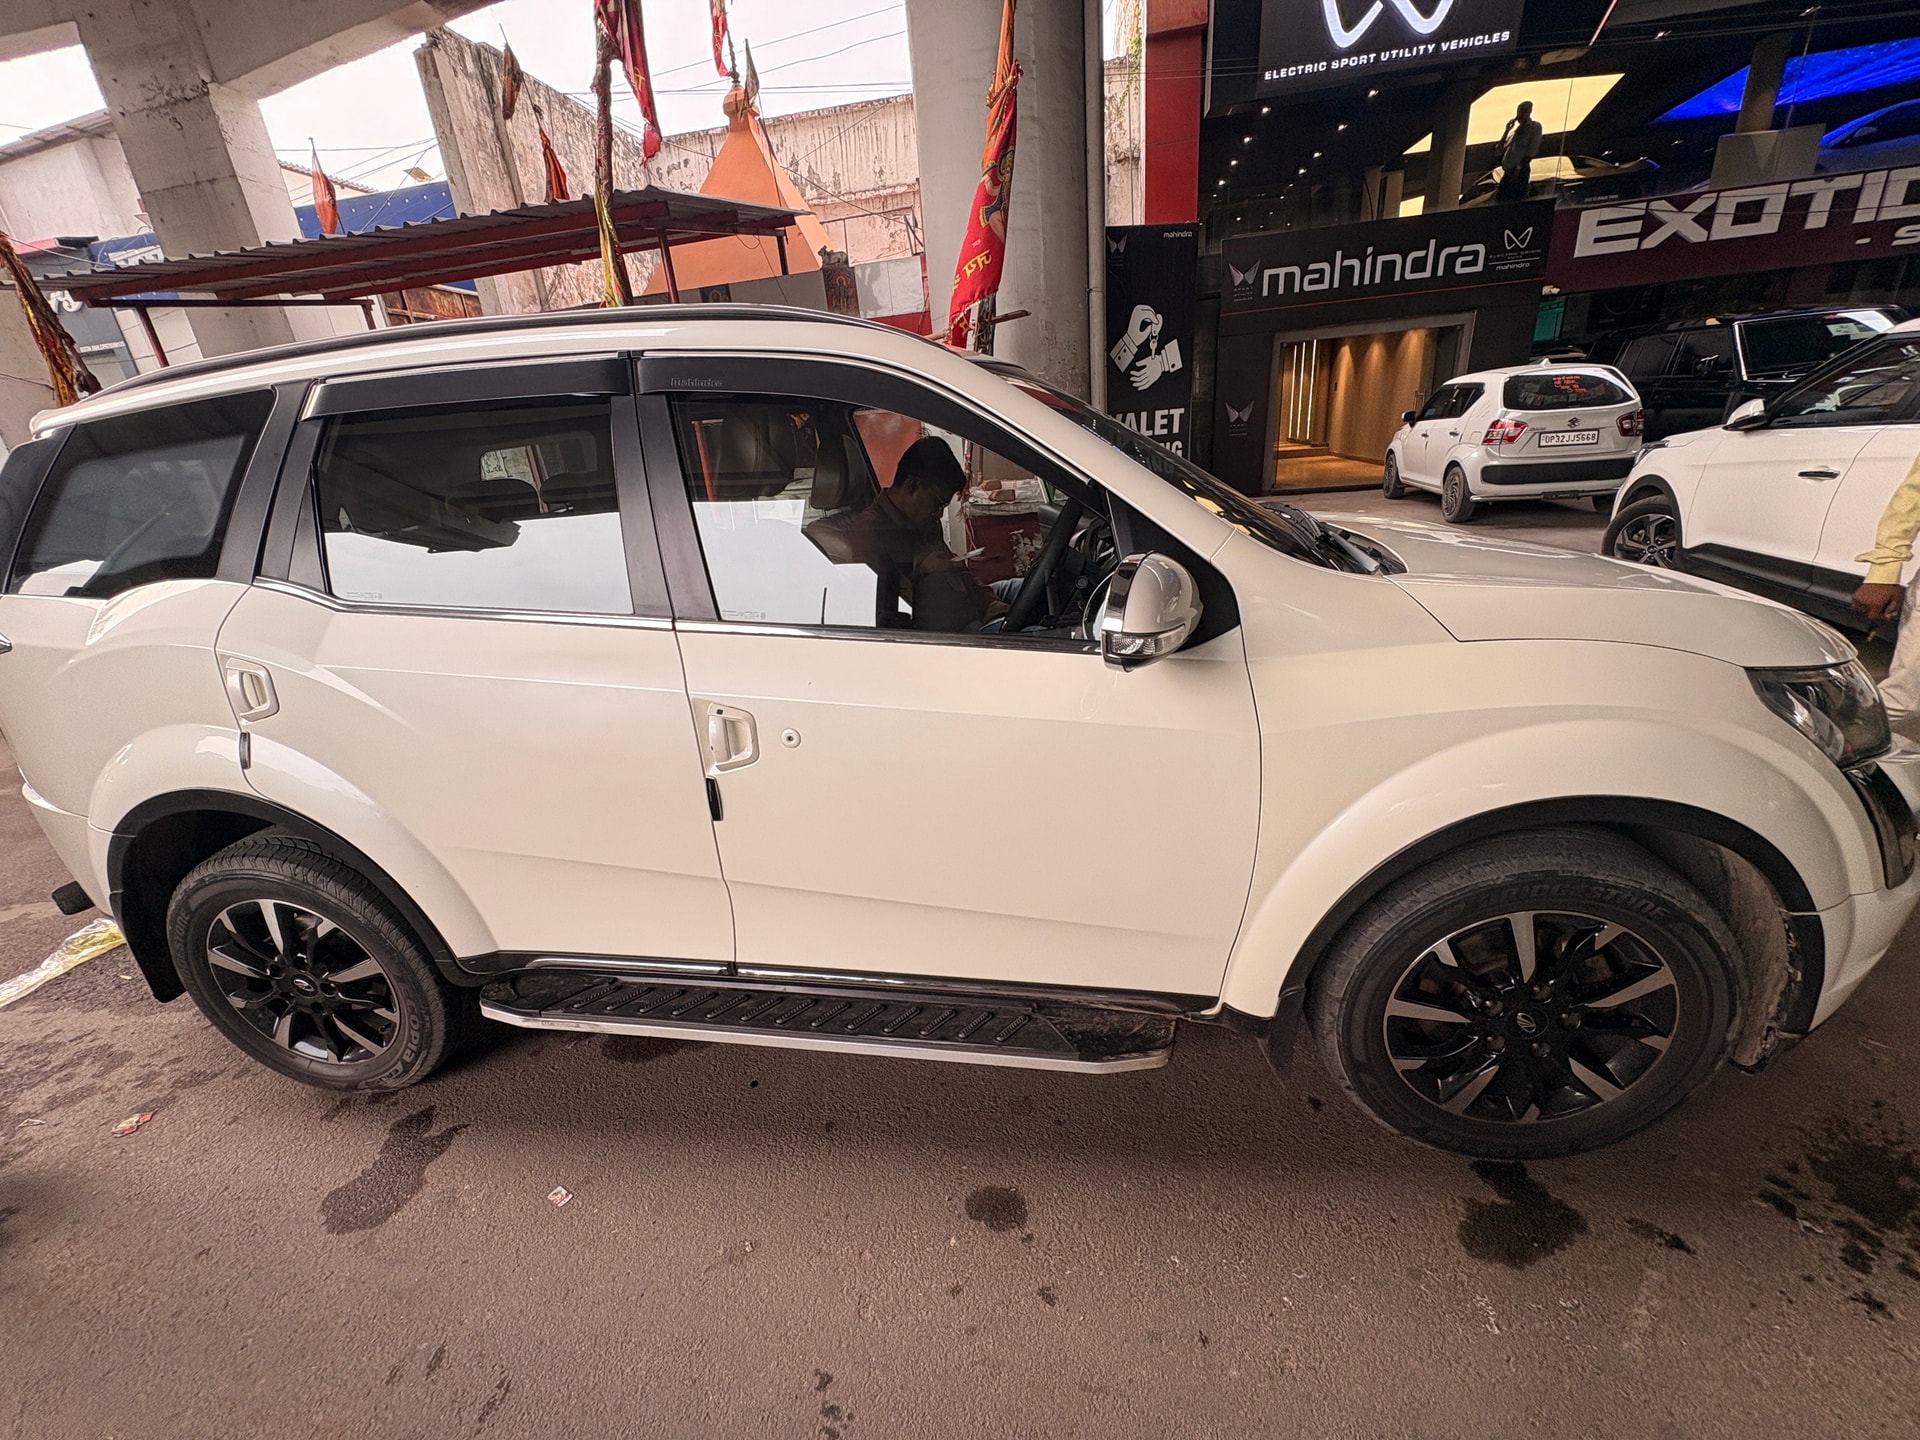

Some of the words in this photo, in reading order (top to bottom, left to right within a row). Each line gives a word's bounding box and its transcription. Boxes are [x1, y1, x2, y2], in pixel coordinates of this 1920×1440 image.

[1264, 61, 1328, 81] ELECTRIC
[1331, 53, 1377, 70] SPORT
[1380, 43, 1436, 62] UTILITY
[1441, 31, 1511, 51] VEHICLES
[1163, 230, 1193, 239] mahindra
[1262, 238, 1486, 297] mahindra
[1495, 261, 1531, 271] mahindra
